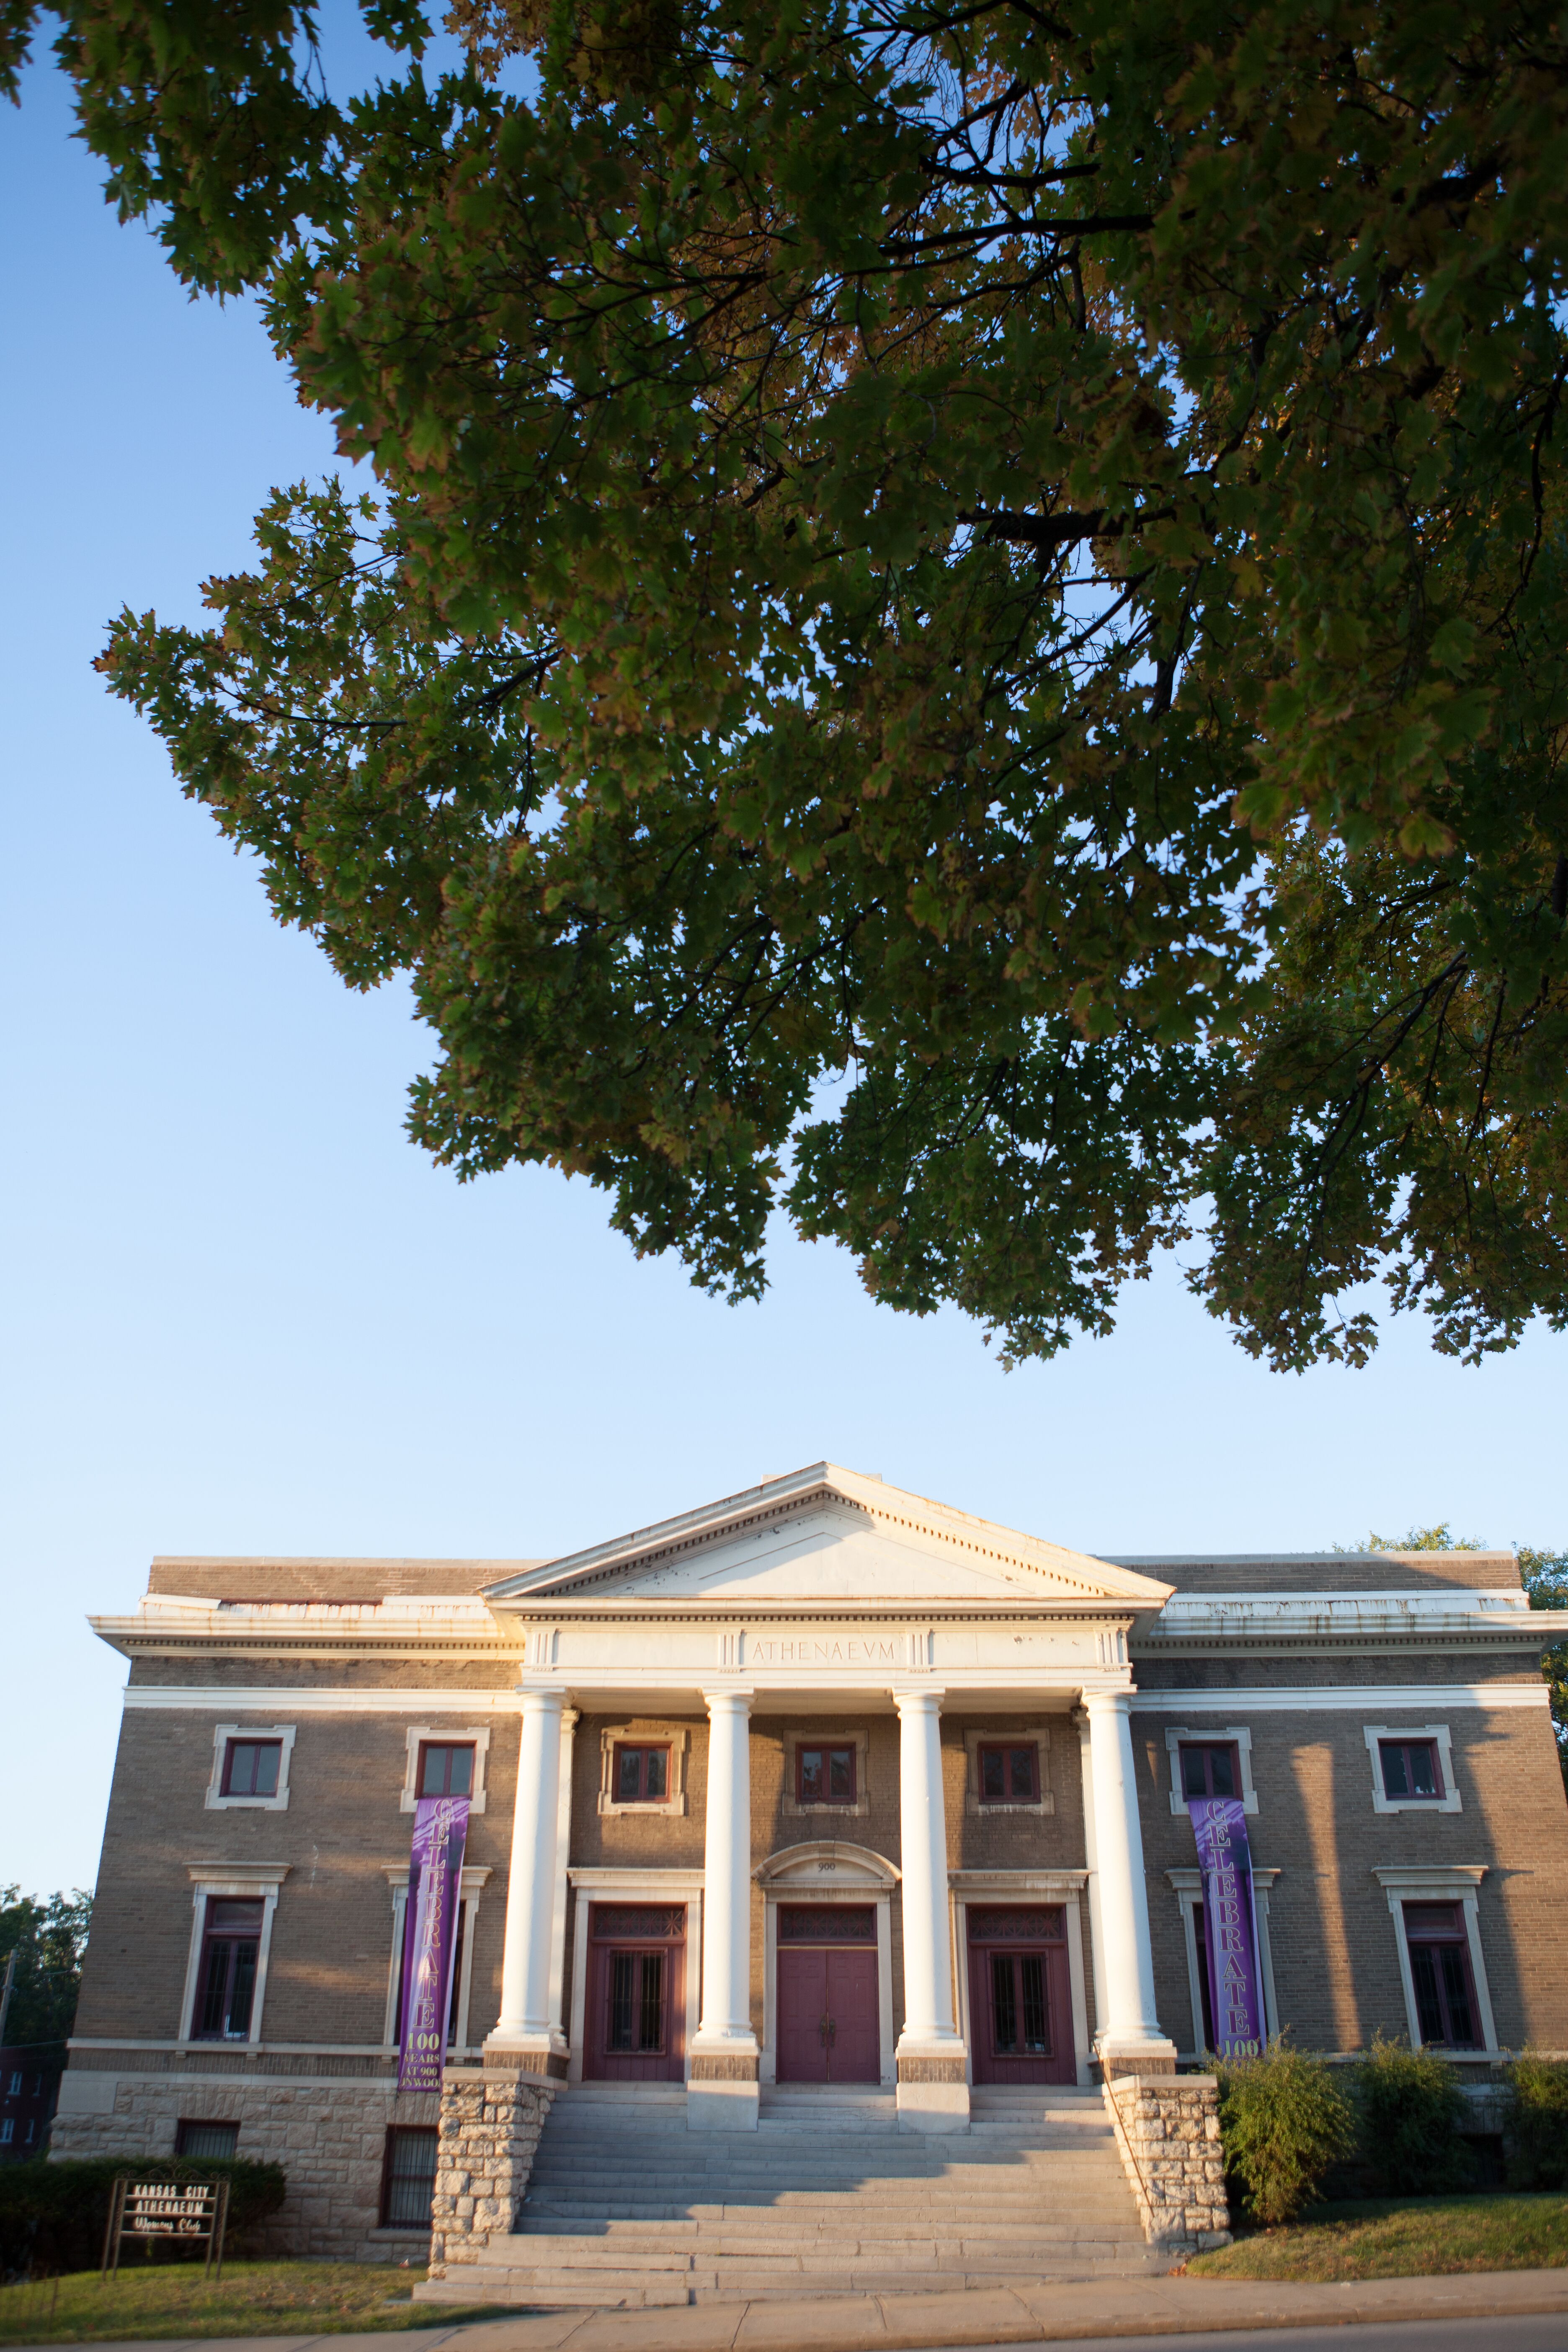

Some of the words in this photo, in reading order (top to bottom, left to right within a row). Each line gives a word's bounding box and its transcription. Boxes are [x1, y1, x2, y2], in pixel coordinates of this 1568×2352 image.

[753, 1641, 894, 1660] ATHENAEVM
[818, 1862, 836, 1872] 900
[413, 1799, 451, 2028] CELEBRATE
[1207, 1800, 1249, 2034] CELEBRATE
[406, 2033, 439, 2050] 100
[1222, 2040, 1258, 2057] 100
[405, 2053, 439, 2063] YEARS
[134, 2184, 176, 2196] KANSAS
[186, 2186, 209, 2197] CITY
[137, 2200, 204, 2213] ATHENAEUM
[179, 2218, 201, 2231] Club
